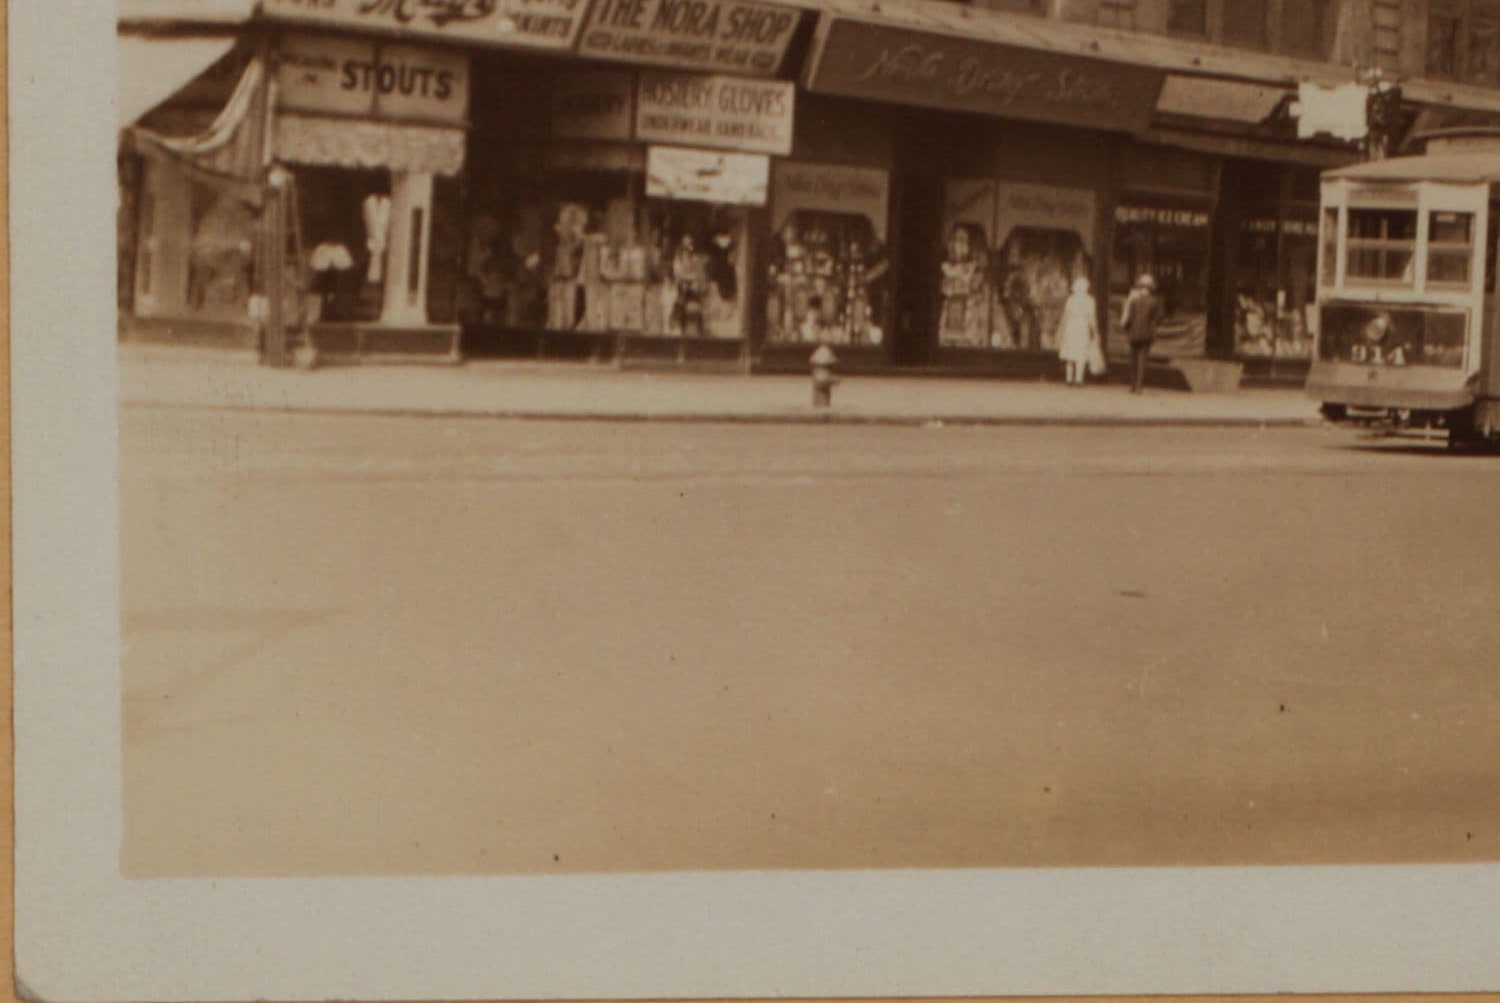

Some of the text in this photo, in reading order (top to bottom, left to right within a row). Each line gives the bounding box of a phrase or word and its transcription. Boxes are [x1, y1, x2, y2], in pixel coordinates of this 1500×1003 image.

[721, 3, 793, 46] SHOP
[340, 58, 454, 102] STOUTS
[717, 82, 786, 117] GLOVES
[1351, 343, 1406, 366] 914
